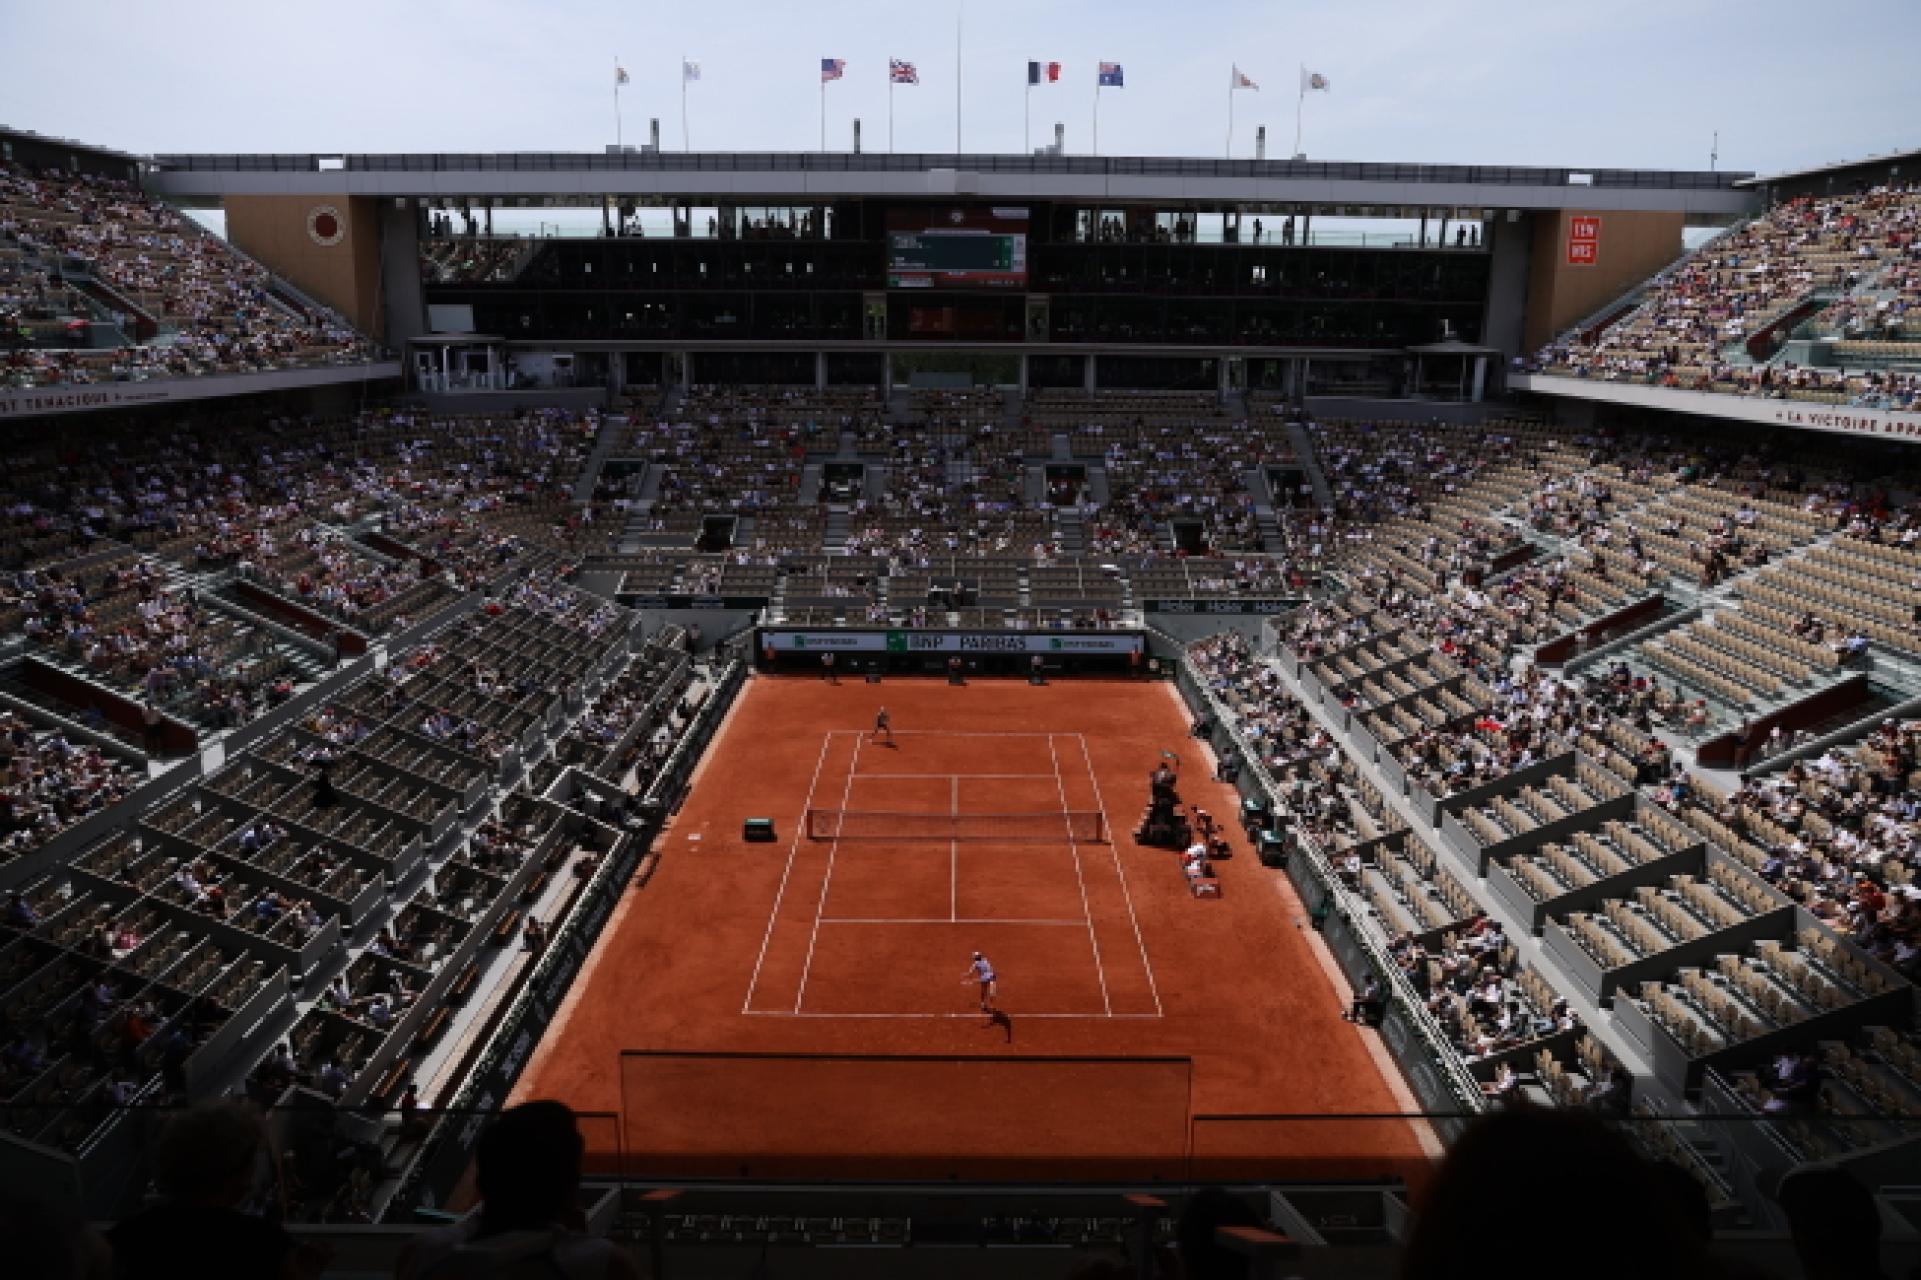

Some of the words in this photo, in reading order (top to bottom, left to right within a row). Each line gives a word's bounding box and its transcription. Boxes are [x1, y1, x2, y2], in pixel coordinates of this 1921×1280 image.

[1809, 413, 1877, 432] VICTOIRE
[909, 634, 944, 649] BNP
[959, 634, 1026, 650] PARIBAS
